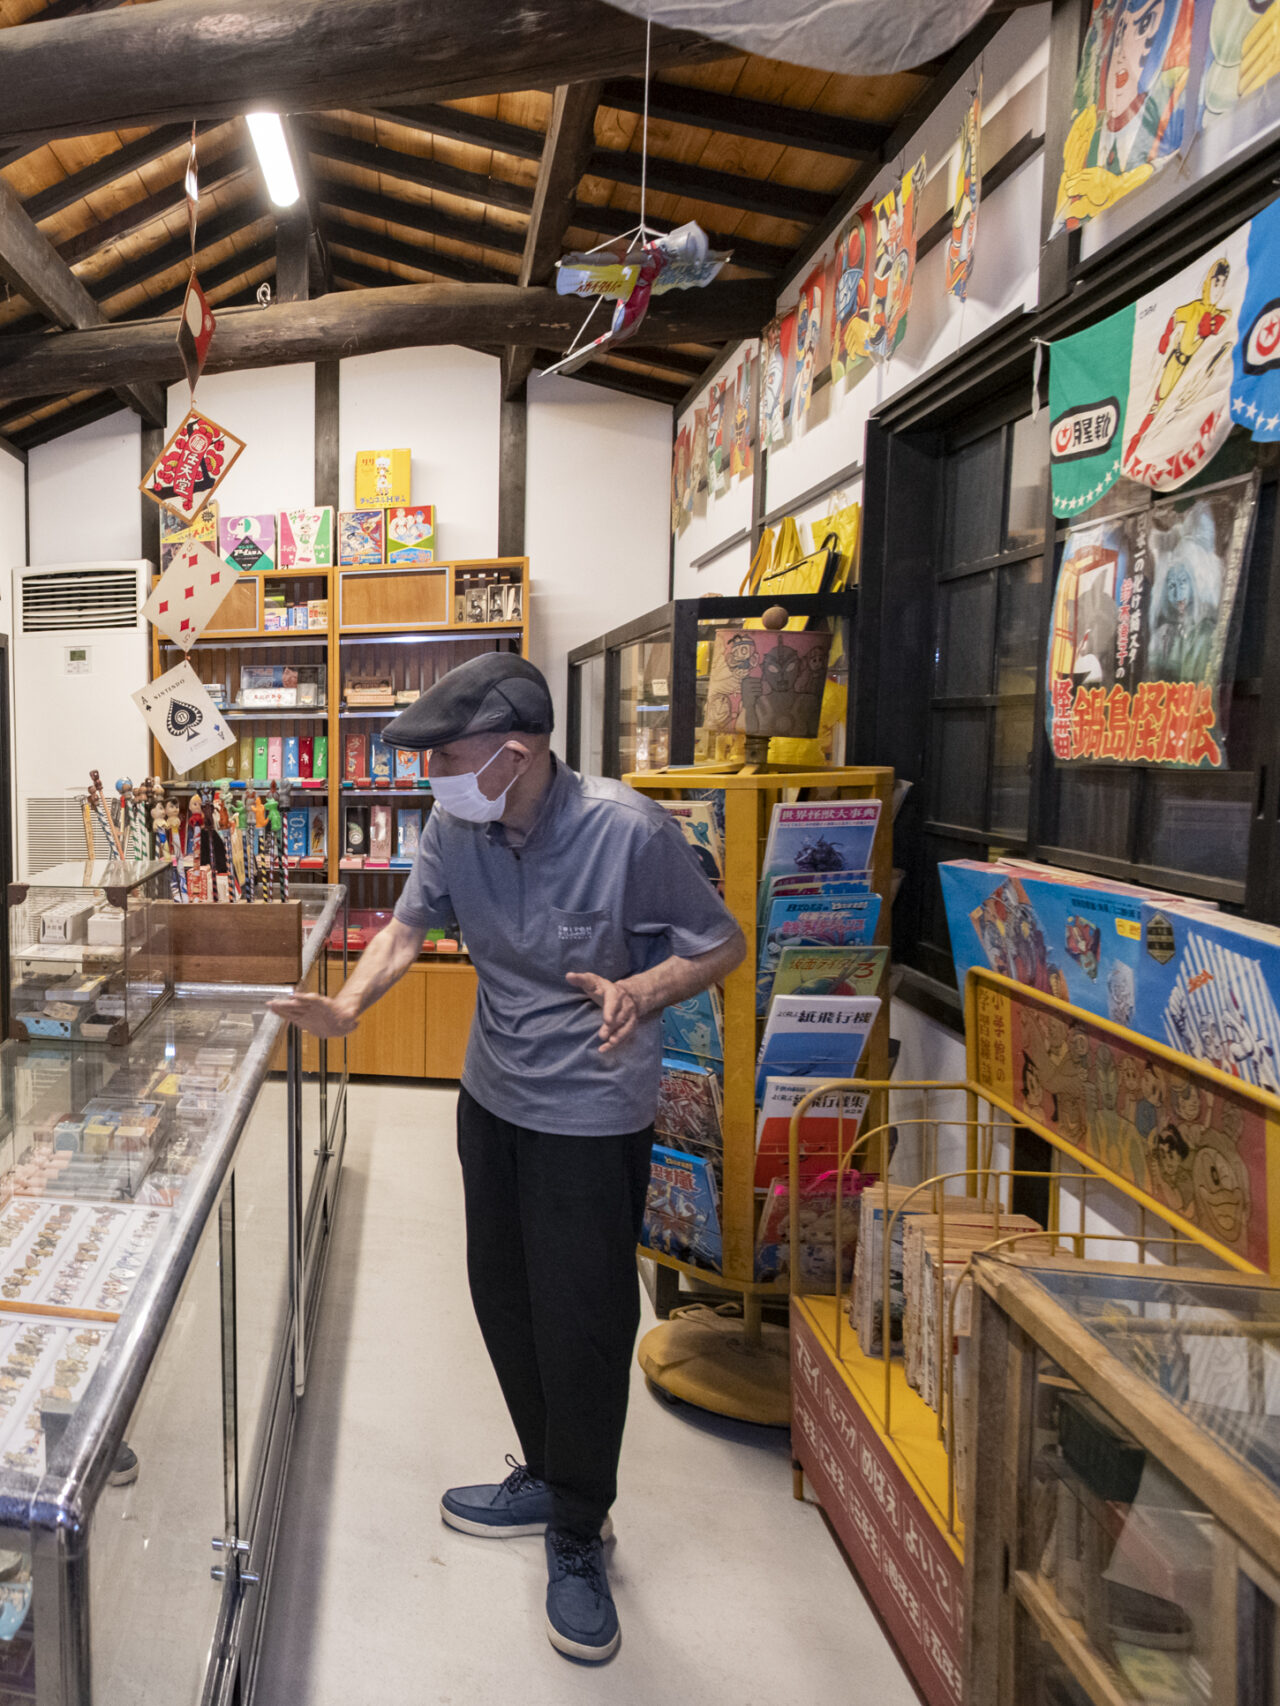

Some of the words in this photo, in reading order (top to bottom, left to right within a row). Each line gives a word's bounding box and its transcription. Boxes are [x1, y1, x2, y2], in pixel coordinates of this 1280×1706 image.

[176, 450, 200, 496] 任天堂
[153, 678, 186, 700] NINTENDO
[782, 807, 875, 820] 世界怪獣大事典
[854, 962, 877, 979] 3
[862, 1443, 899, 1527] めばえ
[904, 1518, 951, 1614] よいこ
